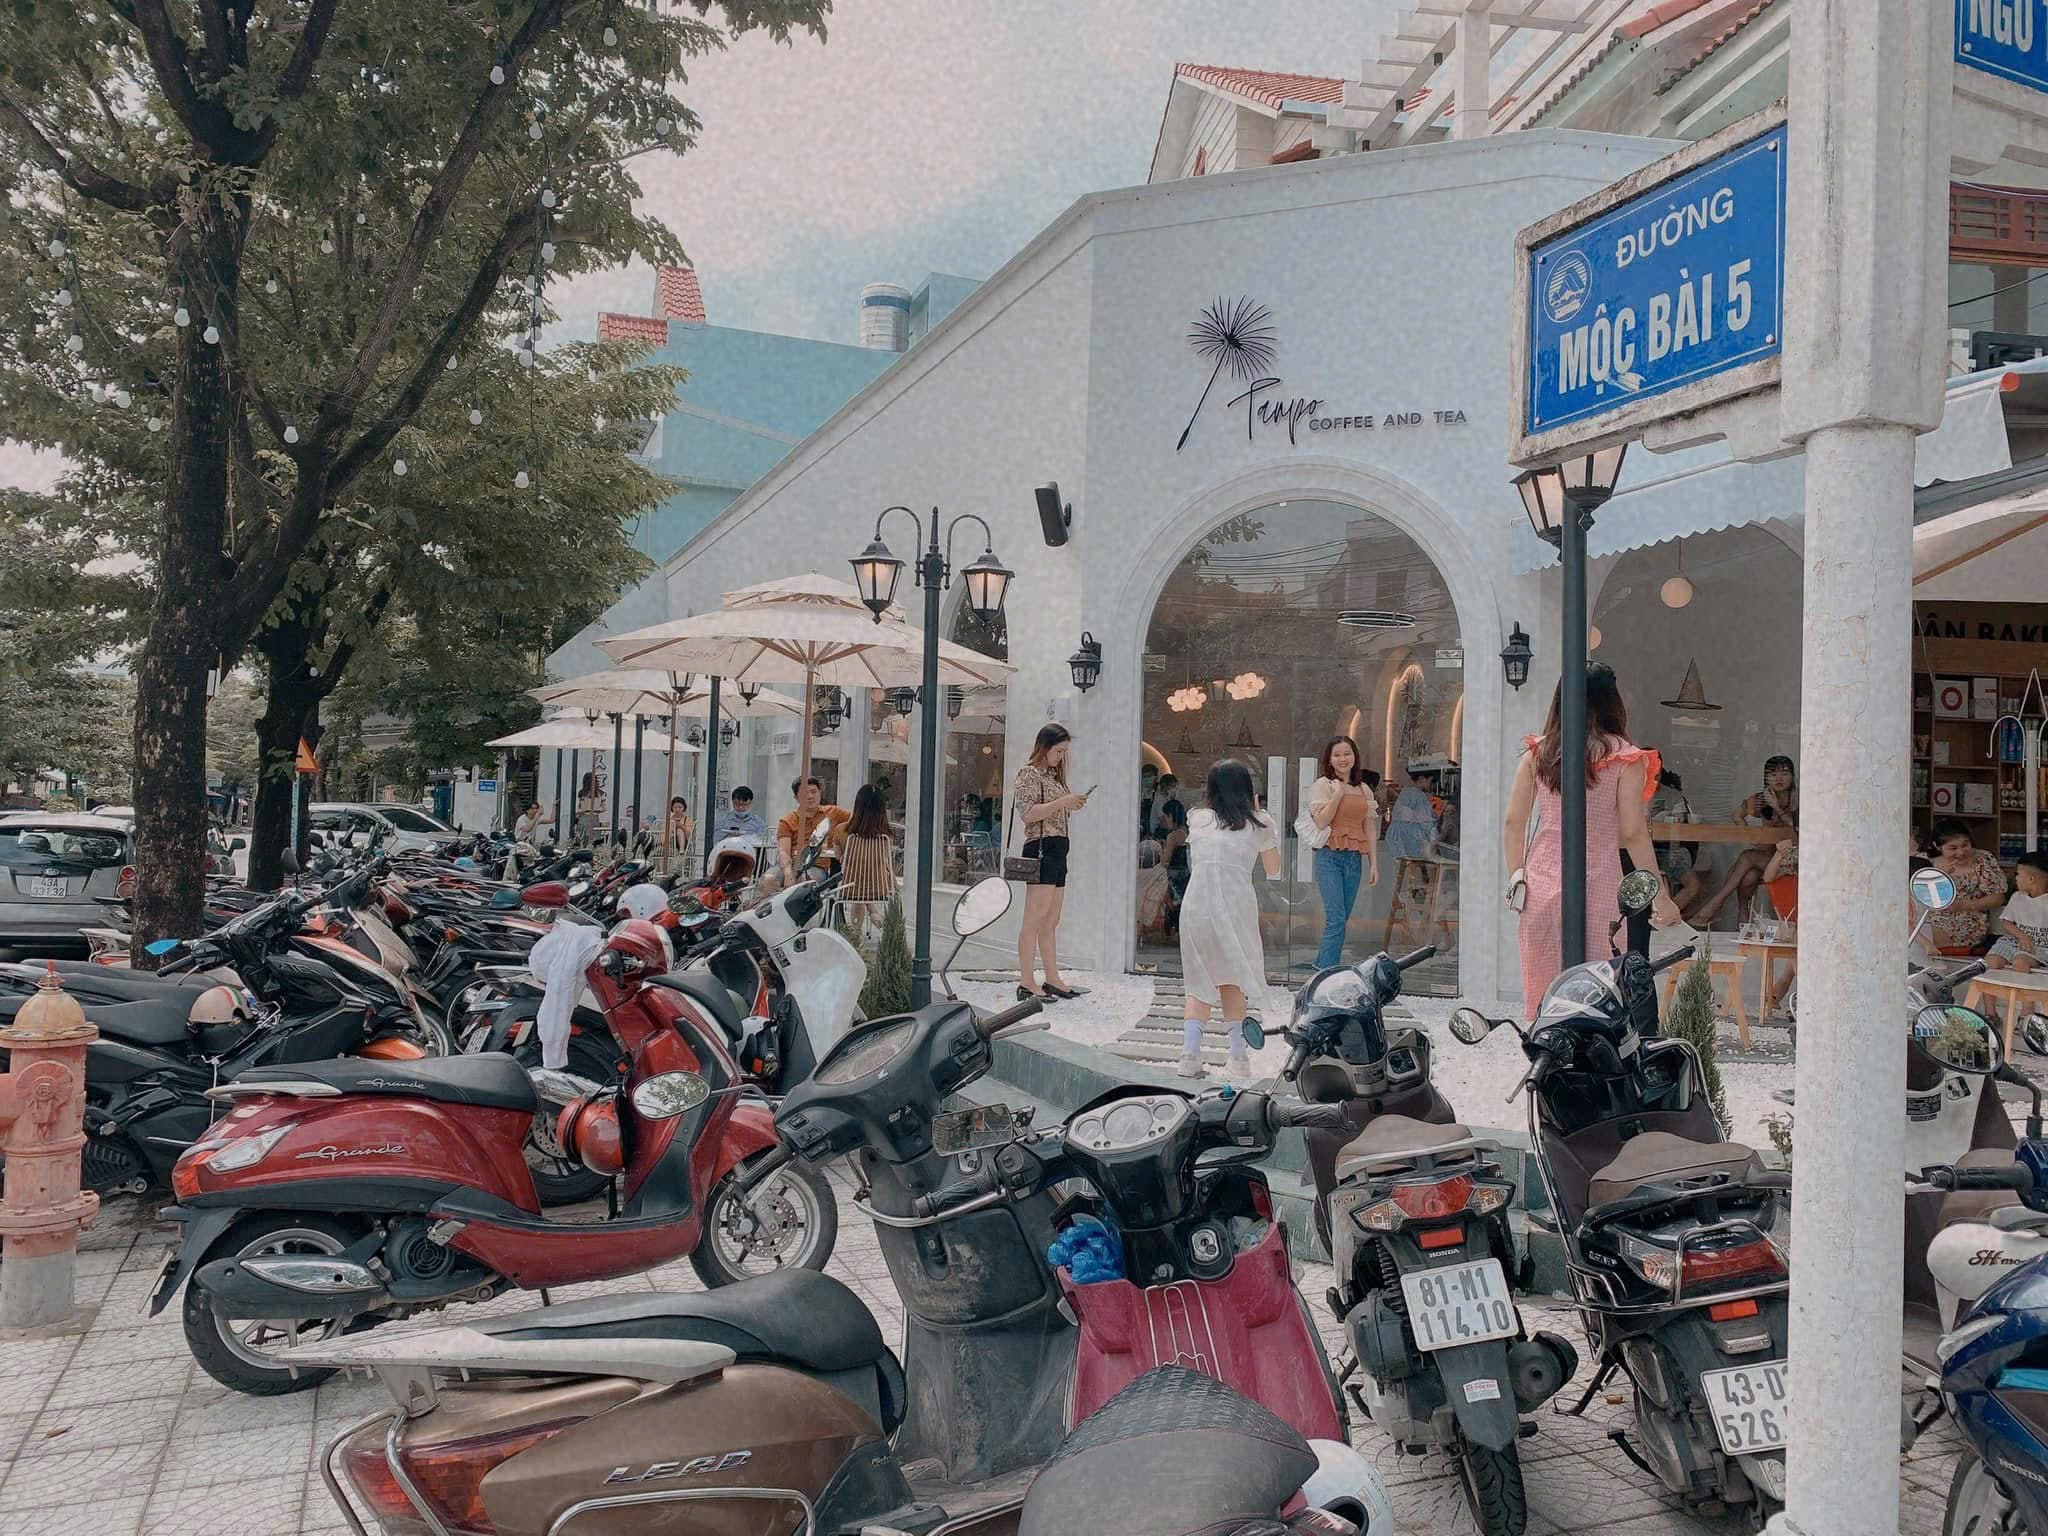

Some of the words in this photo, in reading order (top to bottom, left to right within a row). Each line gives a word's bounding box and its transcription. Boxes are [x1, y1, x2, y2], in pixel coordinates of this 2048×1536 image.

[1616, 187, 1734, 269] ĐƯỜNG
[1558, 303, 1636, 395] MỘC
[1648, 267, 1713, 362] BÀI
[1727, 258, 1751, 332] 5
[1309, 415, 1373, 431] COFFEE
[1383, 412, 1422, 427] AND
[1433, 410, 1467, 424] TEA
[356, 1078, 427, 1090] Grande
[296, 1144, 405, 1162] Grande
[1429, 1248, 1460, 1259] HONDA
[1695, 1232, 1741, 1243] HONDA
[1419, 1267, 1490, 1307] 81-M1
[1420, 1300, 1510, 1343] 114.10
[1720, 1405, 1787, 1448] 526
[602, 1450, 753, 1485] LEAD
